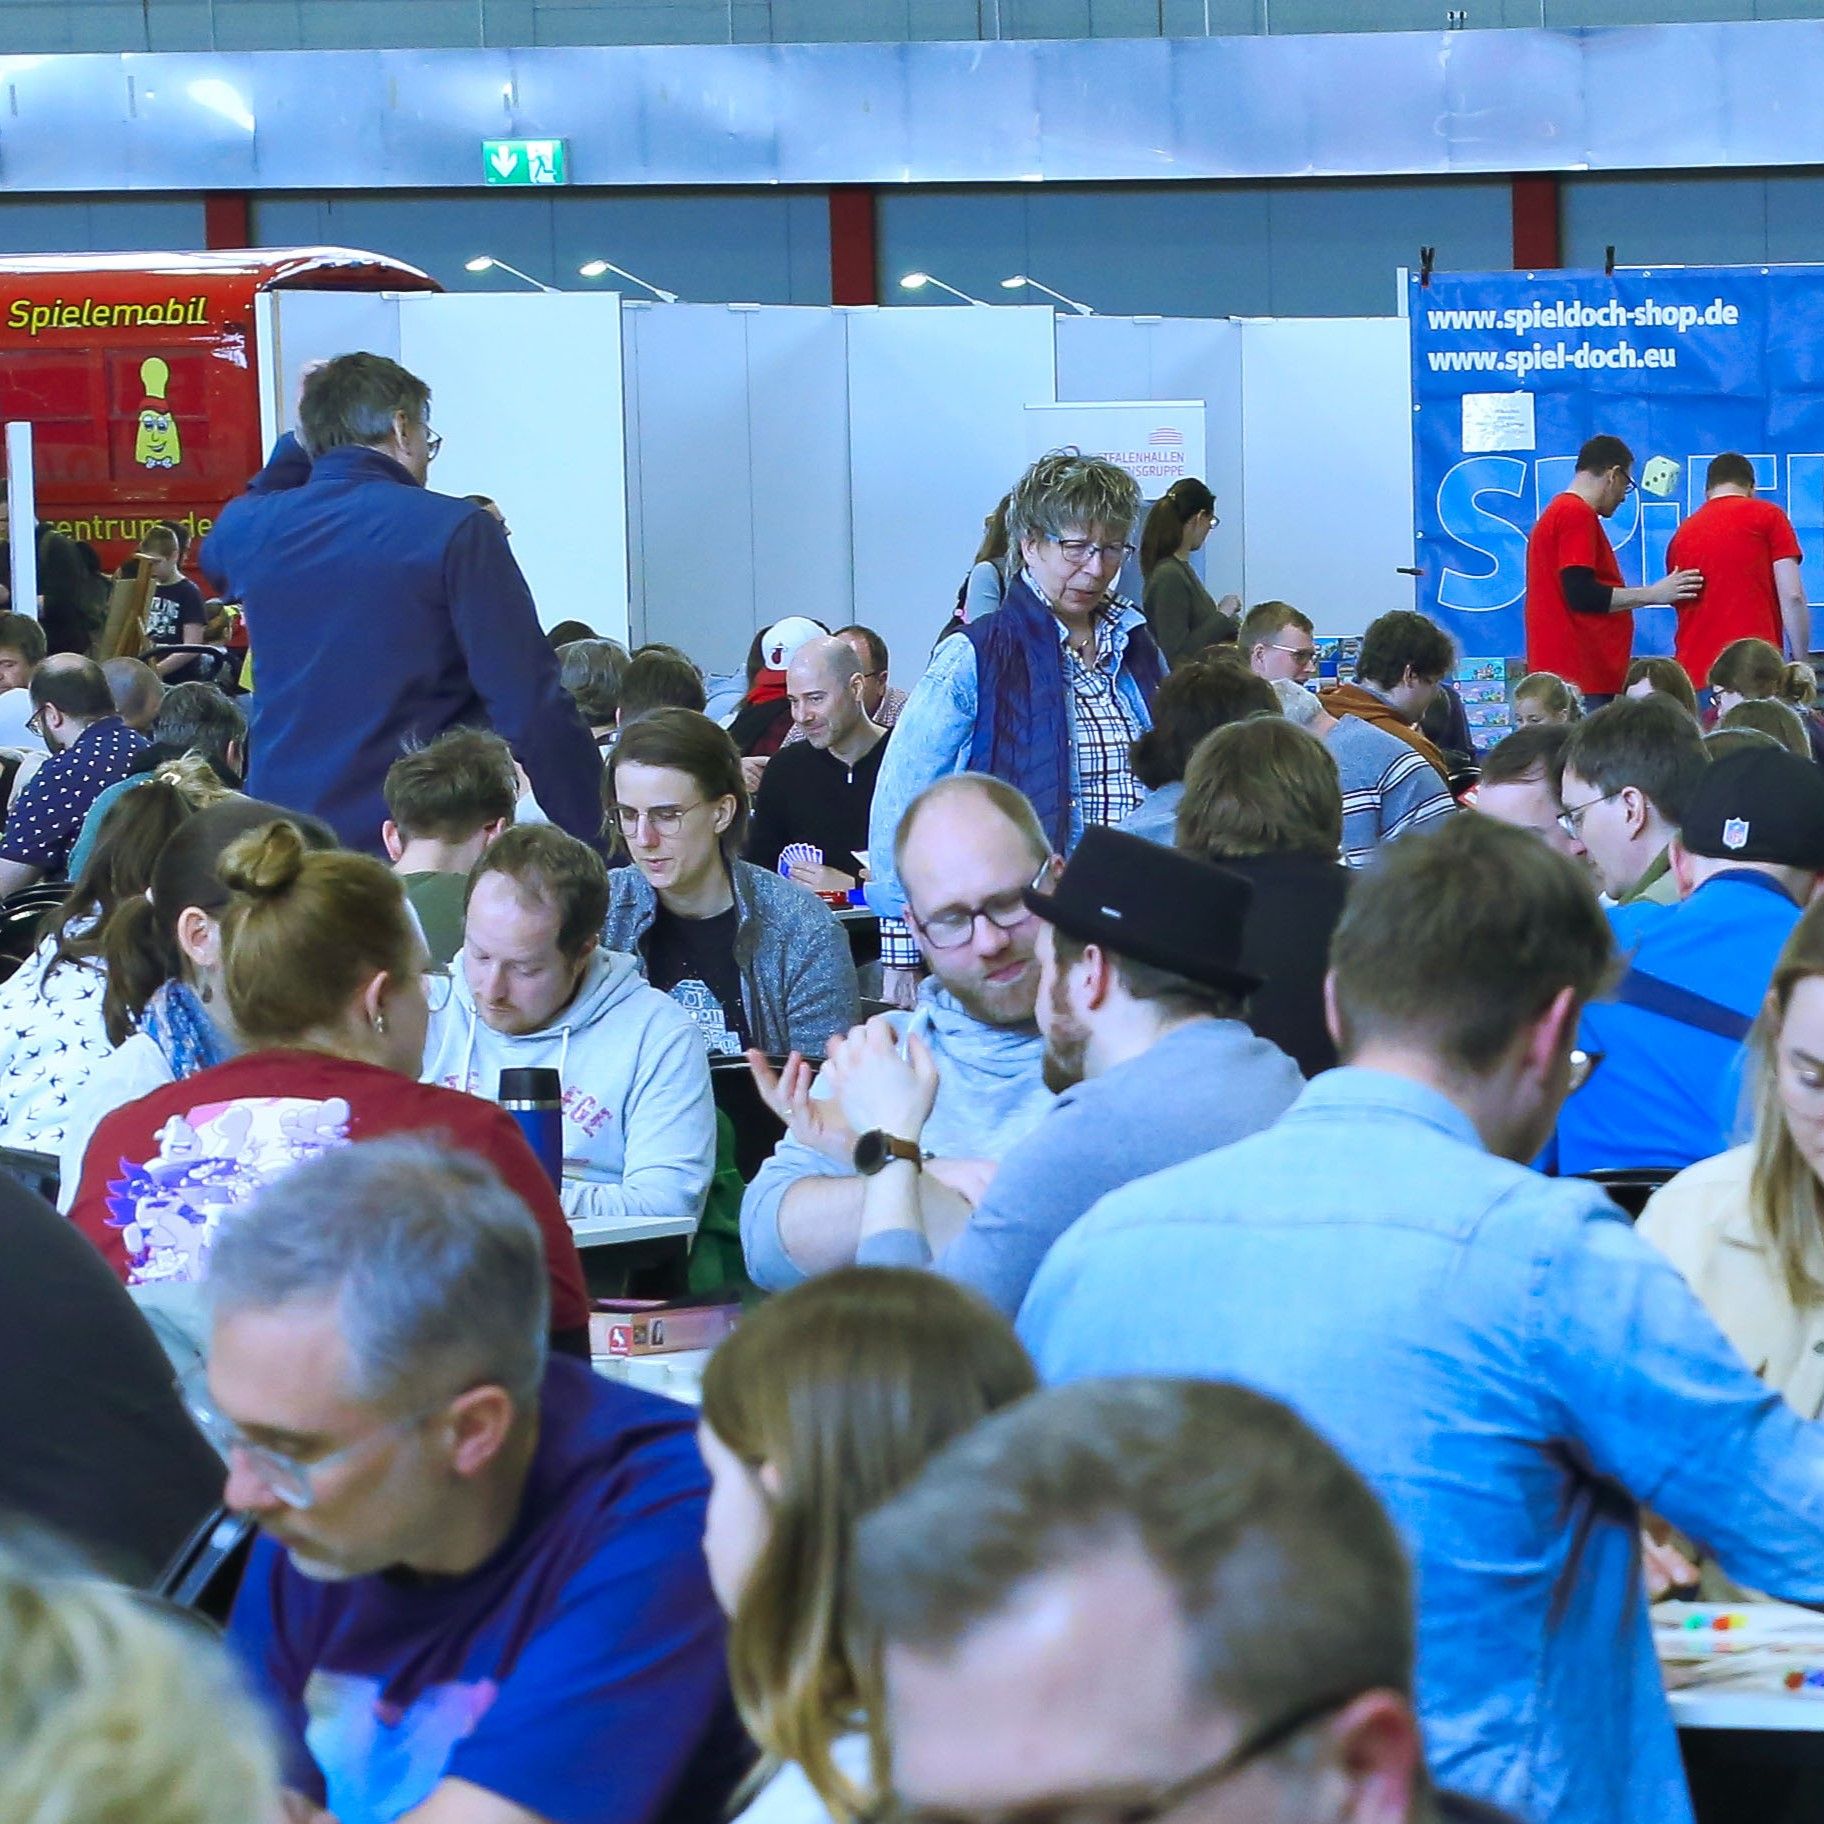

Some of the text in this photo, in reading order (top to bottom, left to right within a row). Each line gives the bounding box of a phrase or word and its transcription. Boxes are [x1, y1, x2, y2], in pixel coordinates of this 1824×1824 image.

[8, 297, 208, 335] Spielemobil
[1427, 298, 1739, 336] www.spieldoch-shop.de
[1427, 341, 1677, 377] www.spiel-doch.eu
[1099, 451, 1184, 463] TFALENHALLEN
